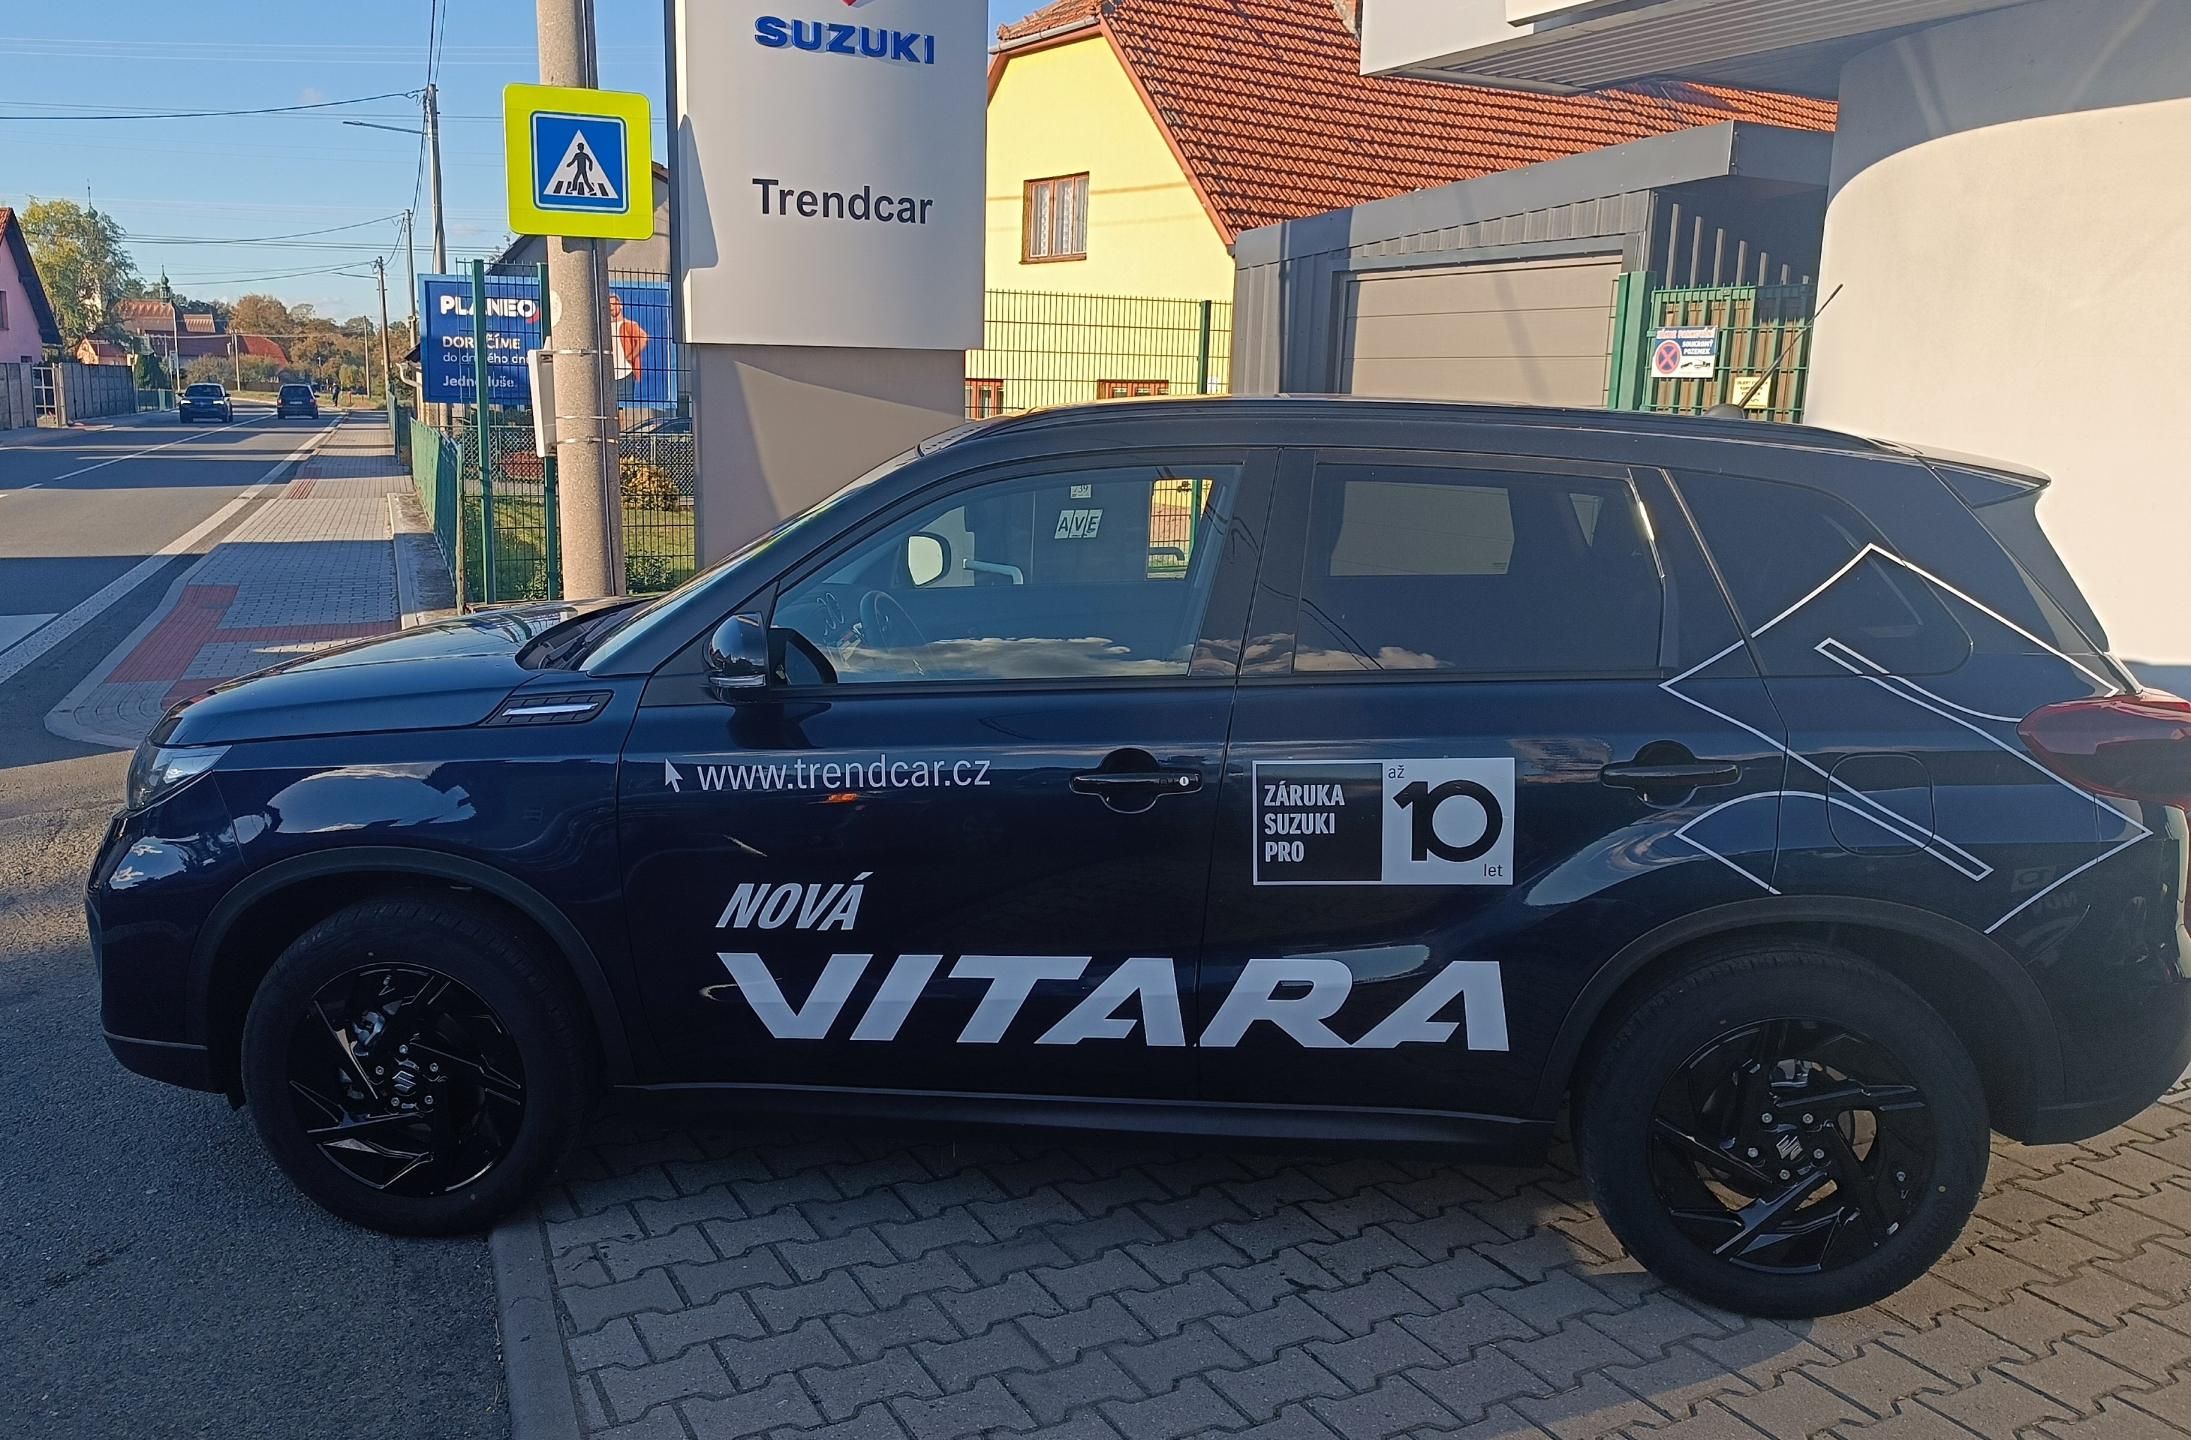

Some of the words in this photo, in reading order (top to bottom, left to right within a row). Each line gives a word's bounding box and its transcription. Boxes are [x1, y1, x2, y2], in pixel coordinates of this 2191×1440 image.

[755, 16, 935, 64] SUZUKI
[752, 178, 933, 224] Trendcar
[442, 333, 521, 350] DORČÍME
[443, 352, 458, 362] do
[461, 352, 508, 364] drého
[1057, 514, 1100, 534] AVE
[697, 753, 991, 791] www.trendcar.cz
[1388, 765, 1405, 779] až
[1264, 780, 1345, 806] ZÁRUKA
[1264, 812, 1336, 835] SUZUKI
[1392, 779, 1503, 862] 10
[1264, 841, 1305, 863] PRO
[1483, 864, 1503, 877] let
[715, 871, 874, 931] NOVÁ
[716, 952, 1510, 1052] VITARA
